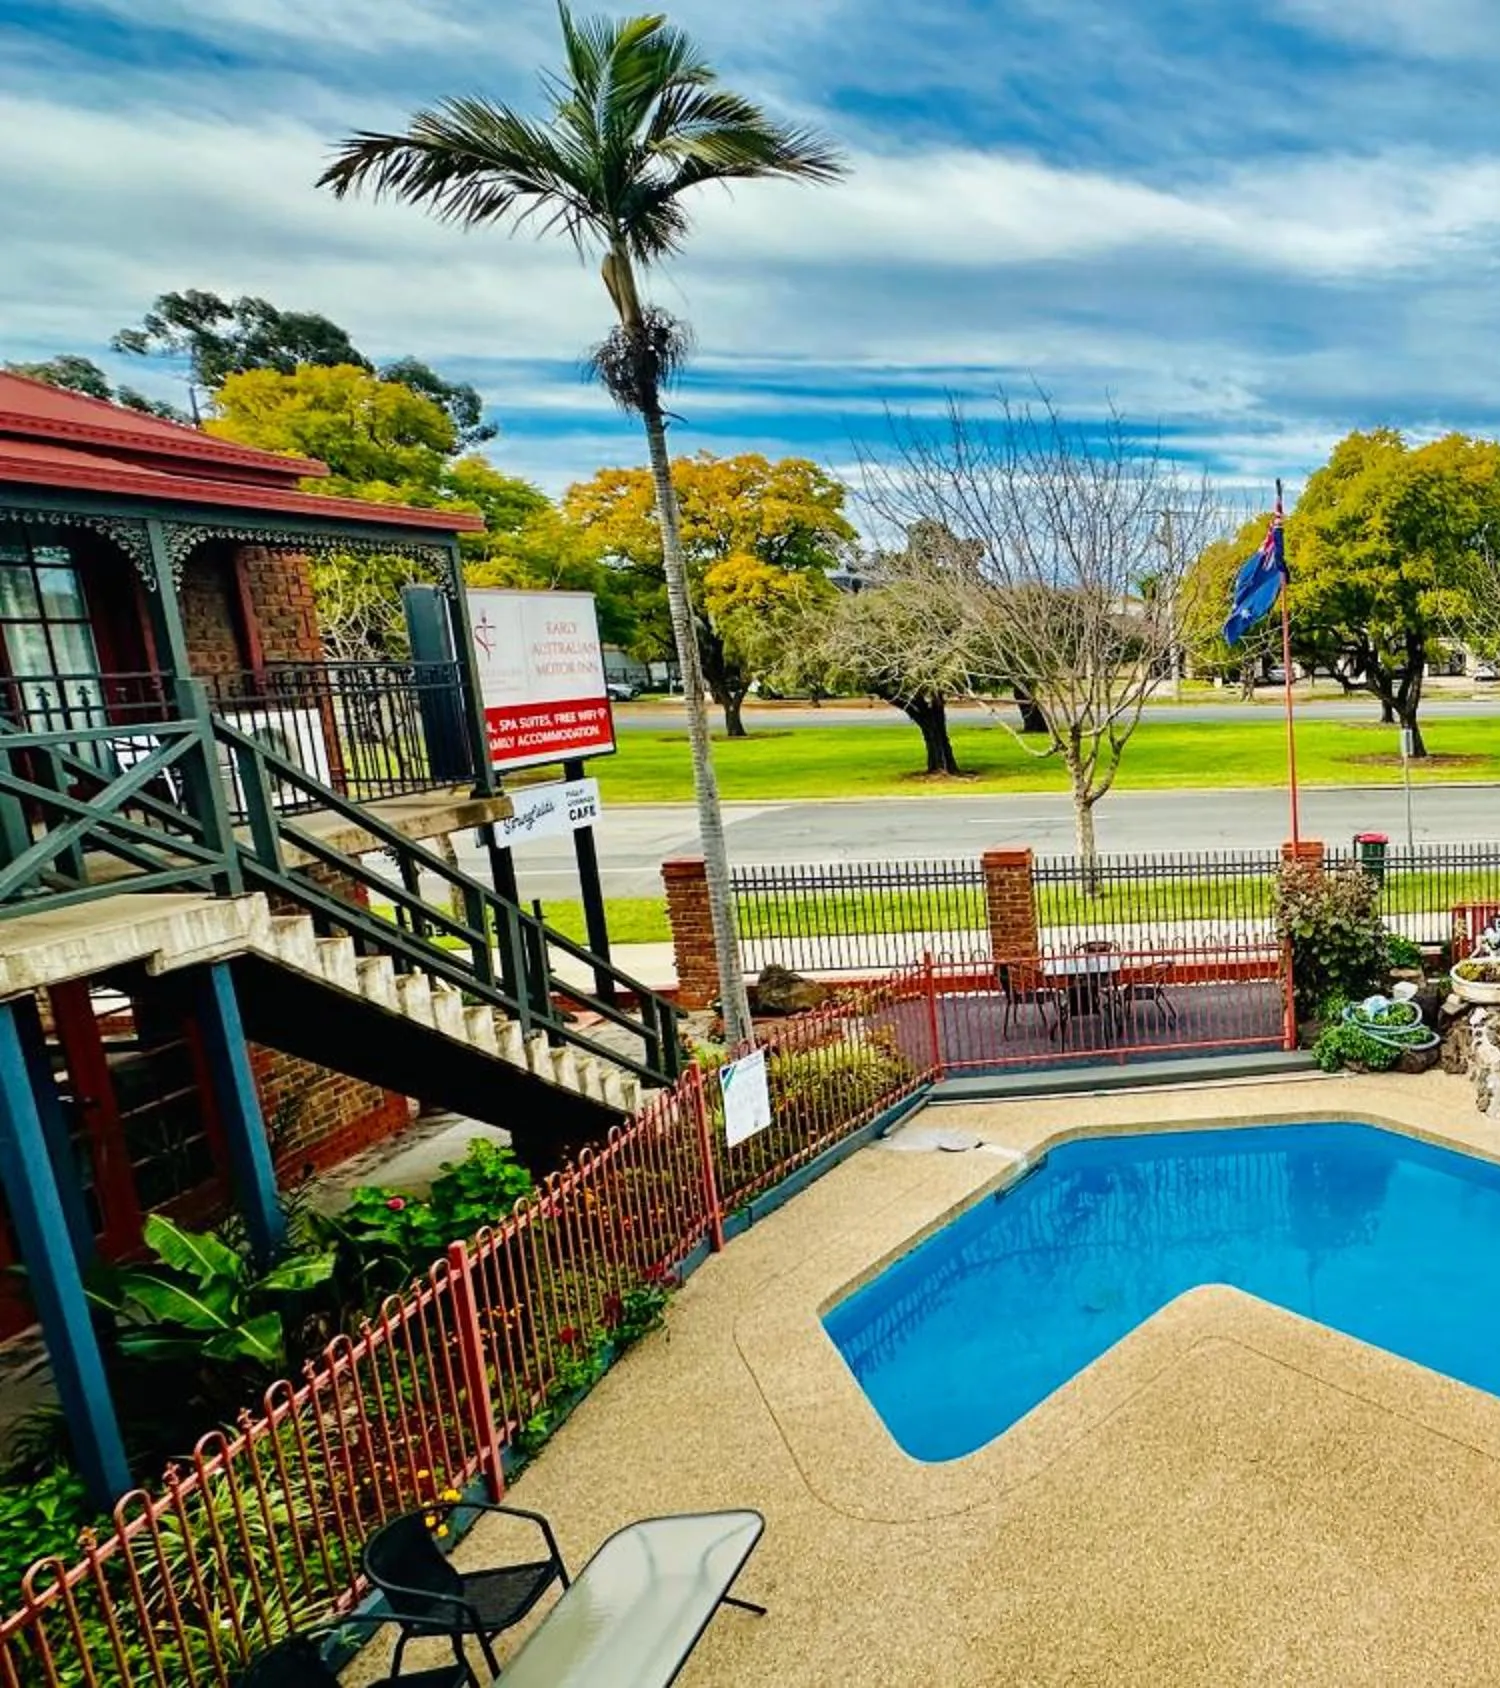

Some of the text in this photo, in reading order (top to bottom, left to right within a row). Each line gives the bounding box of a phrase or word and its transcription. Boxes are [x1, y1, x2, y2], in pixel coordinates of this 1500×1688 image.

[499, 717, 518, 732] SPA
[554, 711, 576, 725] FREE
[489, 725, 600, 751] AMILY ACCOMMODATION
[569, 804, 597, 821] CAFE
